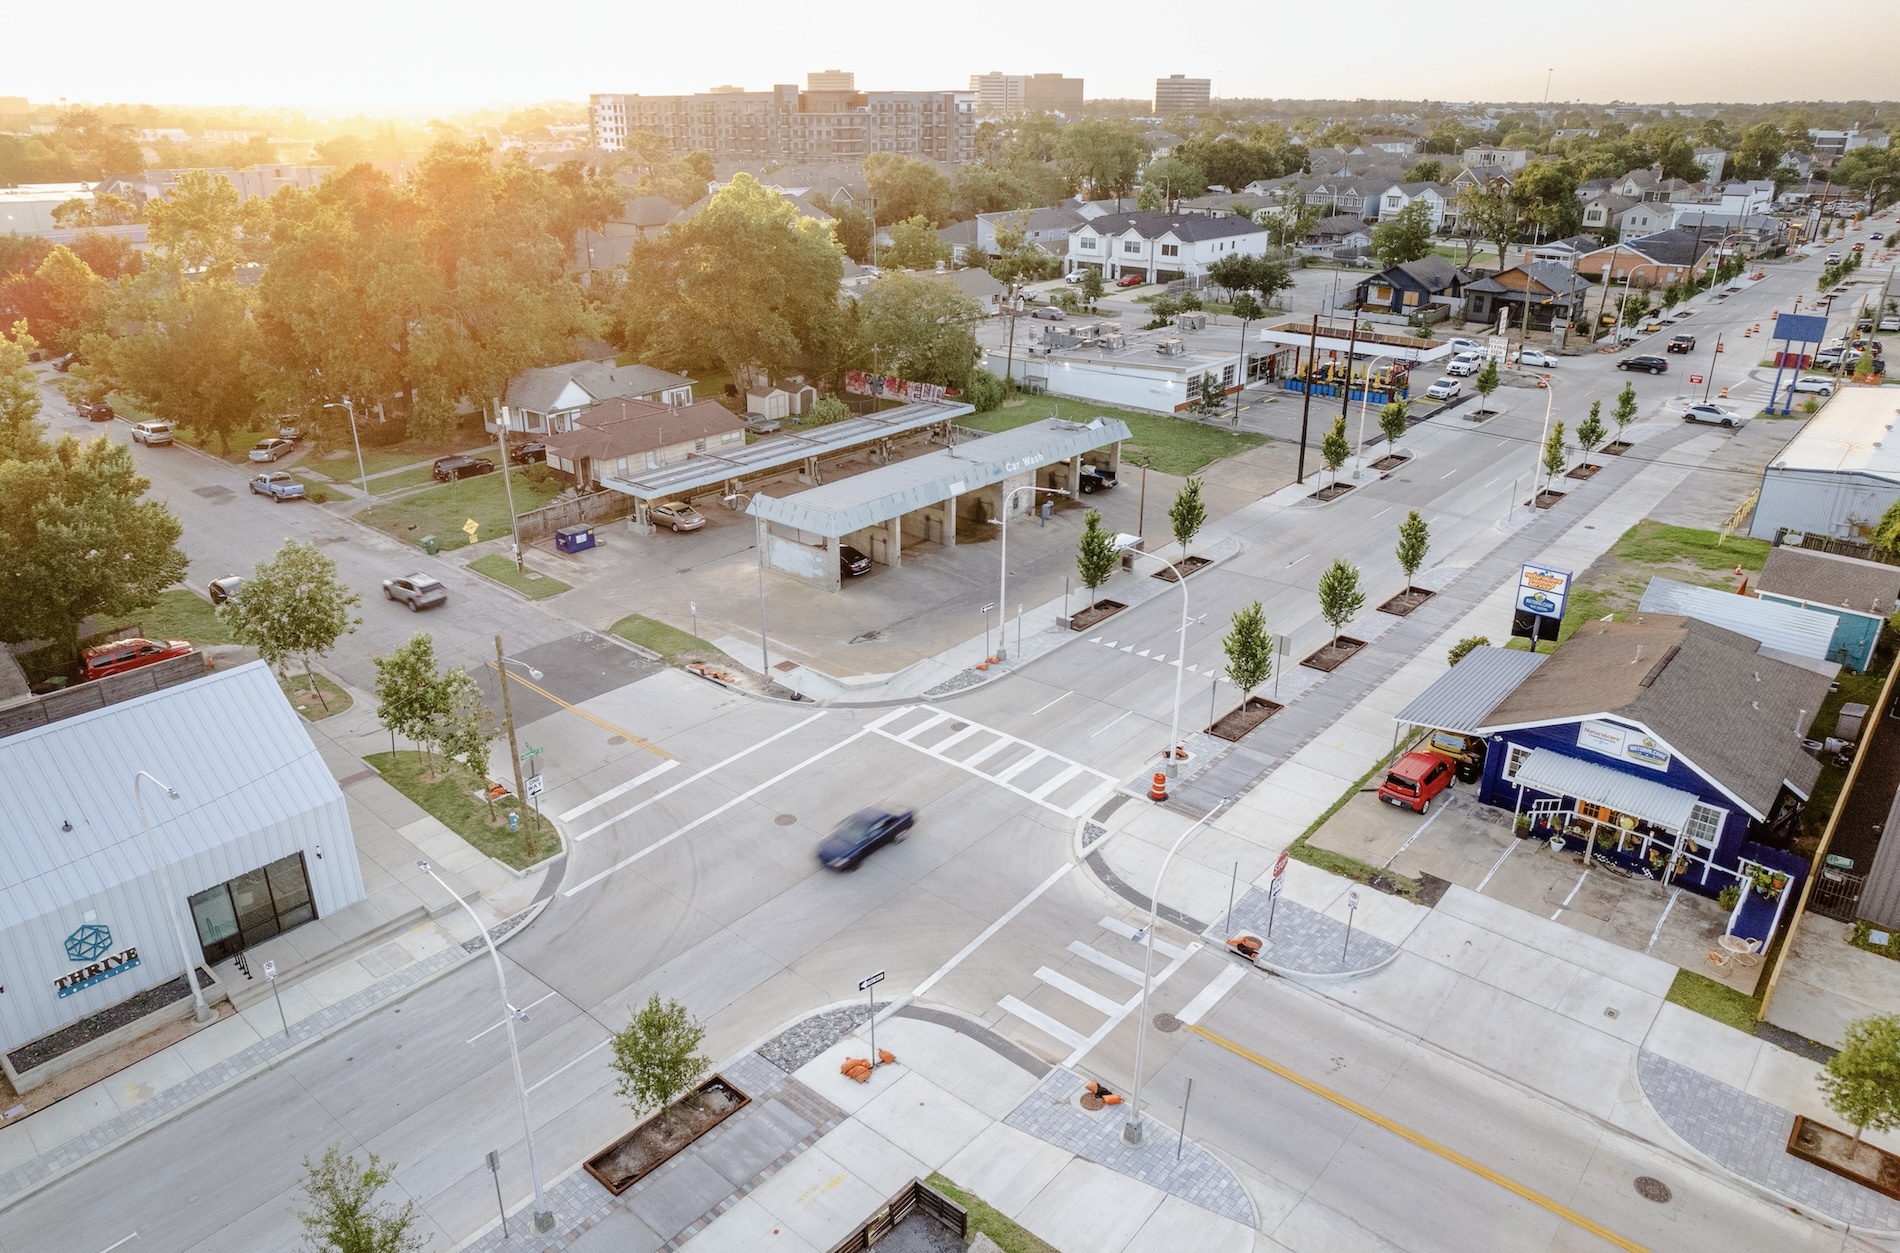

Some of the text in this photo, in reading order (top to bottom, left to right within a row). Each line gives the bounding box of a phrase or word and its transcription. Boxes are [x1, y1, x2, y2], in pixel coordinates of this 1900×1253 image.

[1005, 453, 1044, 472] Car Wash
[1584, 727, 1620, 742] Naturalcare
[528, 782, 542, 791] WAY
[529, 777, 541, 786] ONE
[1273, 857, 1288, 874] STOP
[54, 947, 138, 991] THRIVE
